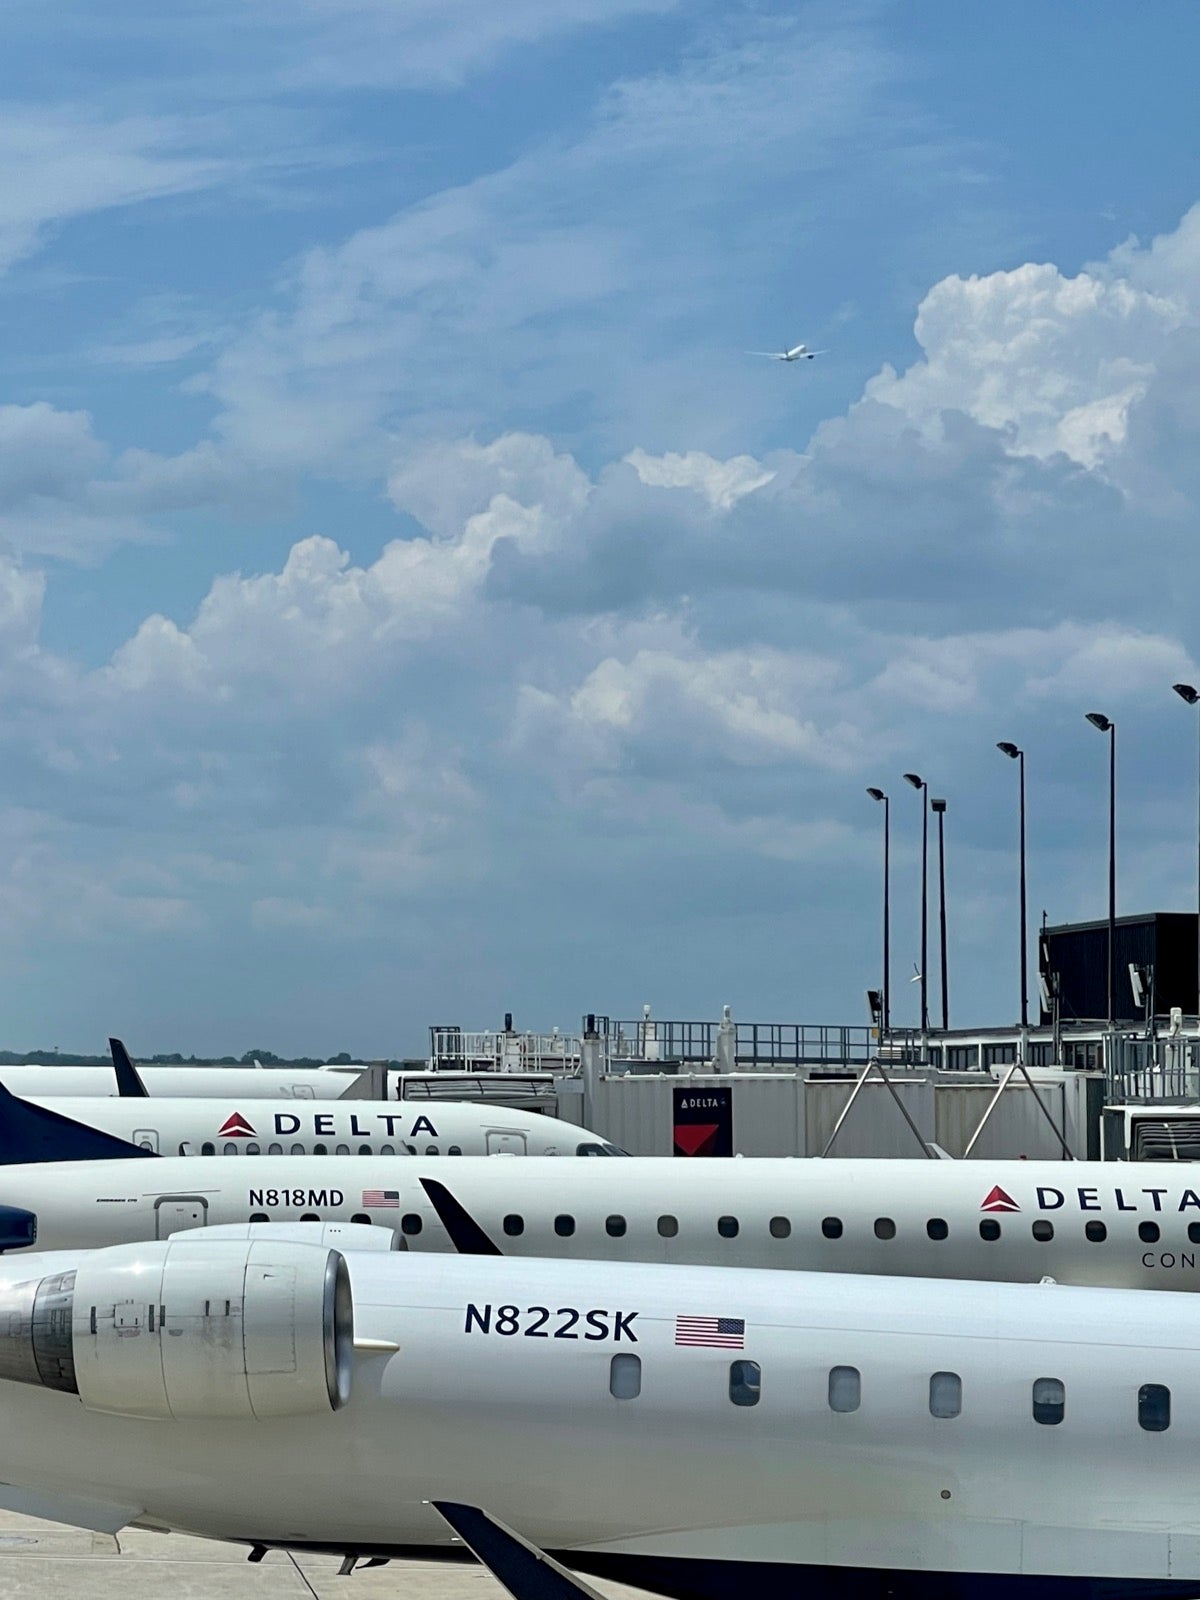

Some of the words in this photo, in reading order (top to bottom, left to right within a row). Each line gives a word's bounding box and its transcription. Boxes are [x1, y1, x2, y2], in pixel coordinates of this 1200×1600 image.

[690, 1098, 718, 1108] DELTA
[274, 1113, 439, 1137] DELTA
[249, 1189, 344, 1207] N818MD
[1036, 1187, 1200, 1212] DELTA
[1141, 1252, 1196, 1268] CON
[464, 1303, 640, 1343] N822SK
